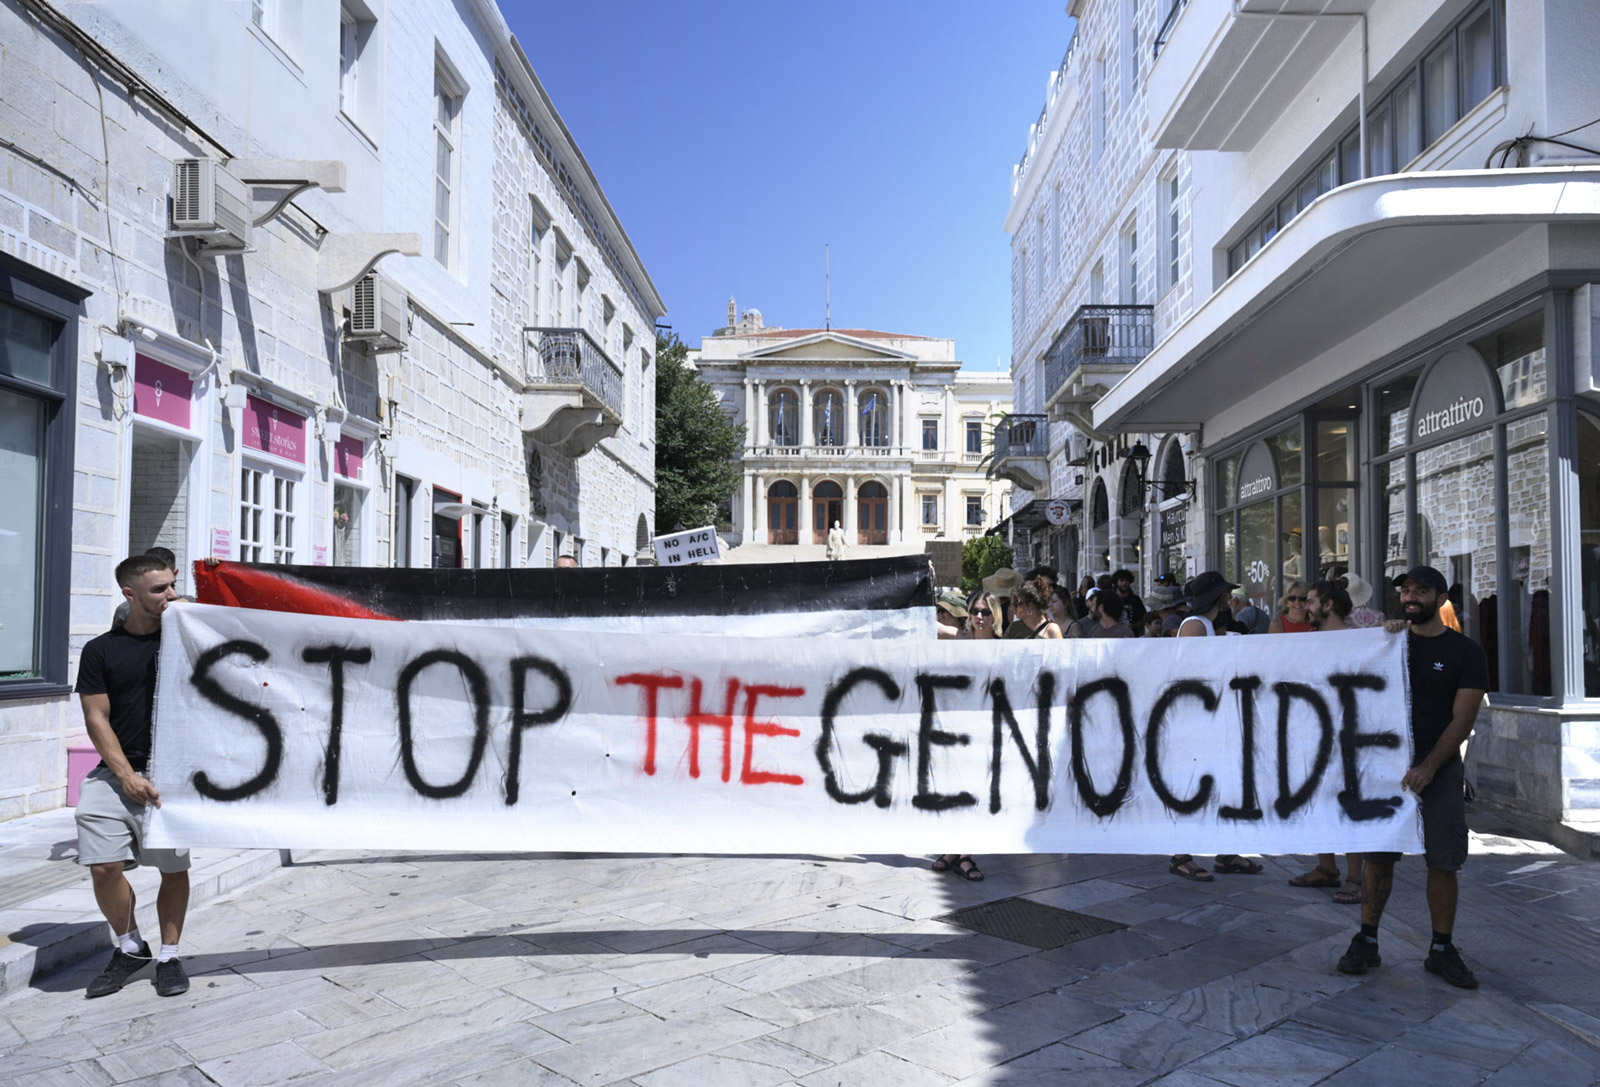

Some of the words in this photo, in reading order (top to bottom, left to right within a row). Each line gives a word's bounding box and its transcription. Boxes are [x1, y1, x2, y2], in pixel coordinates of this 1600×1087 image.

[1417, 396, 1485, 438] attrattivo
[1240, 474, 1273, 500] attrattivo
[1166, 510, 1186, 526] Haircu
[663, 539, 680, 549] NO
[689, 532, 709, 544] A/C
[1163, 531, 1175, 545] Men
[668, 554, 681, 564] IN
[688, 547, 716, 559] HELL
[190, 639, 573, 805] STOP
[614, 672, 806, 785] THE
[814, 666, 1402, 821] GENOCIDE
